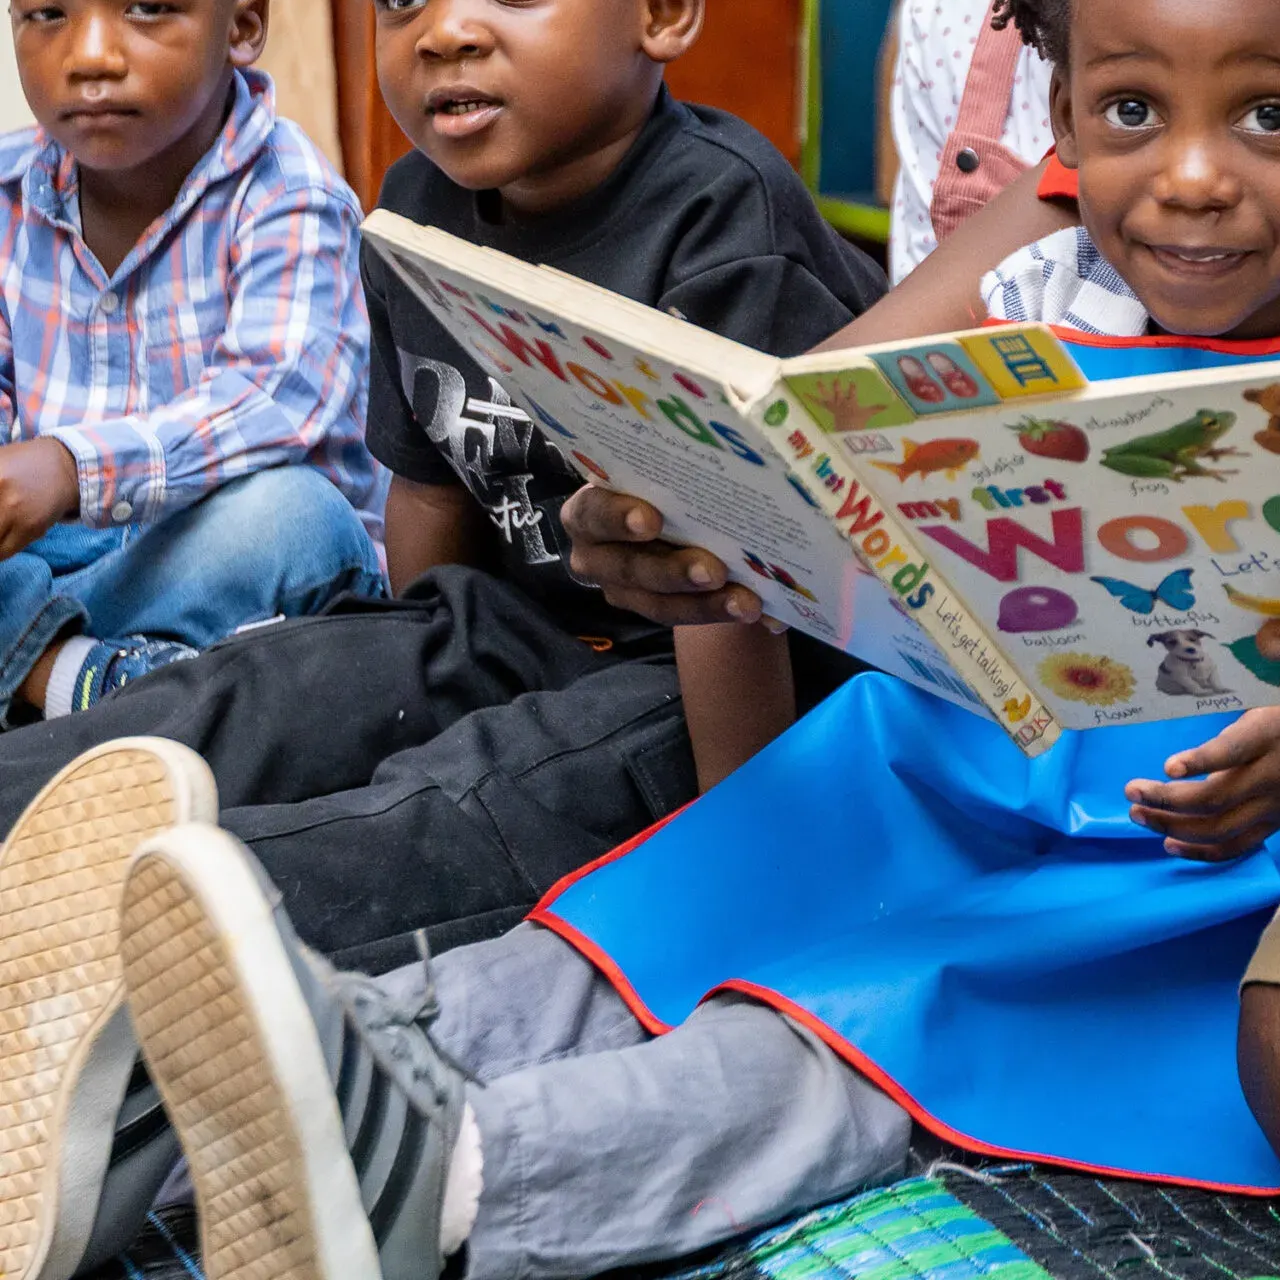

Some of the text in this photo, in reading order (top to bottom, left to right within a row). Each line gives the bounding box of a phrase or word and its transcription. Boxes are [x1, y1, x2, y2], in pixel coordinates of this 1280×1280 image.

[459, 305, 766, 465] Words
[1129, 479, 1170, 496] frog
[897, 478, 1067, 521] my first
[788, 429, 815, 460] my
[811, 452, 846, 494] first
[836, 479, 935, 609] Words
[936, 597, 964, 638] Let's
[952, 635, 980, 657] get
[976, 646, 1017, 698] talking!
[1131, 611, 1220, 628] butterfly
[1022, 633, 1087, 647] balloon
[1195, 695, 1243, 711] puppy
[1094, 705, 1144, 724] flower
[1018, 714, 1049, 743] DK
